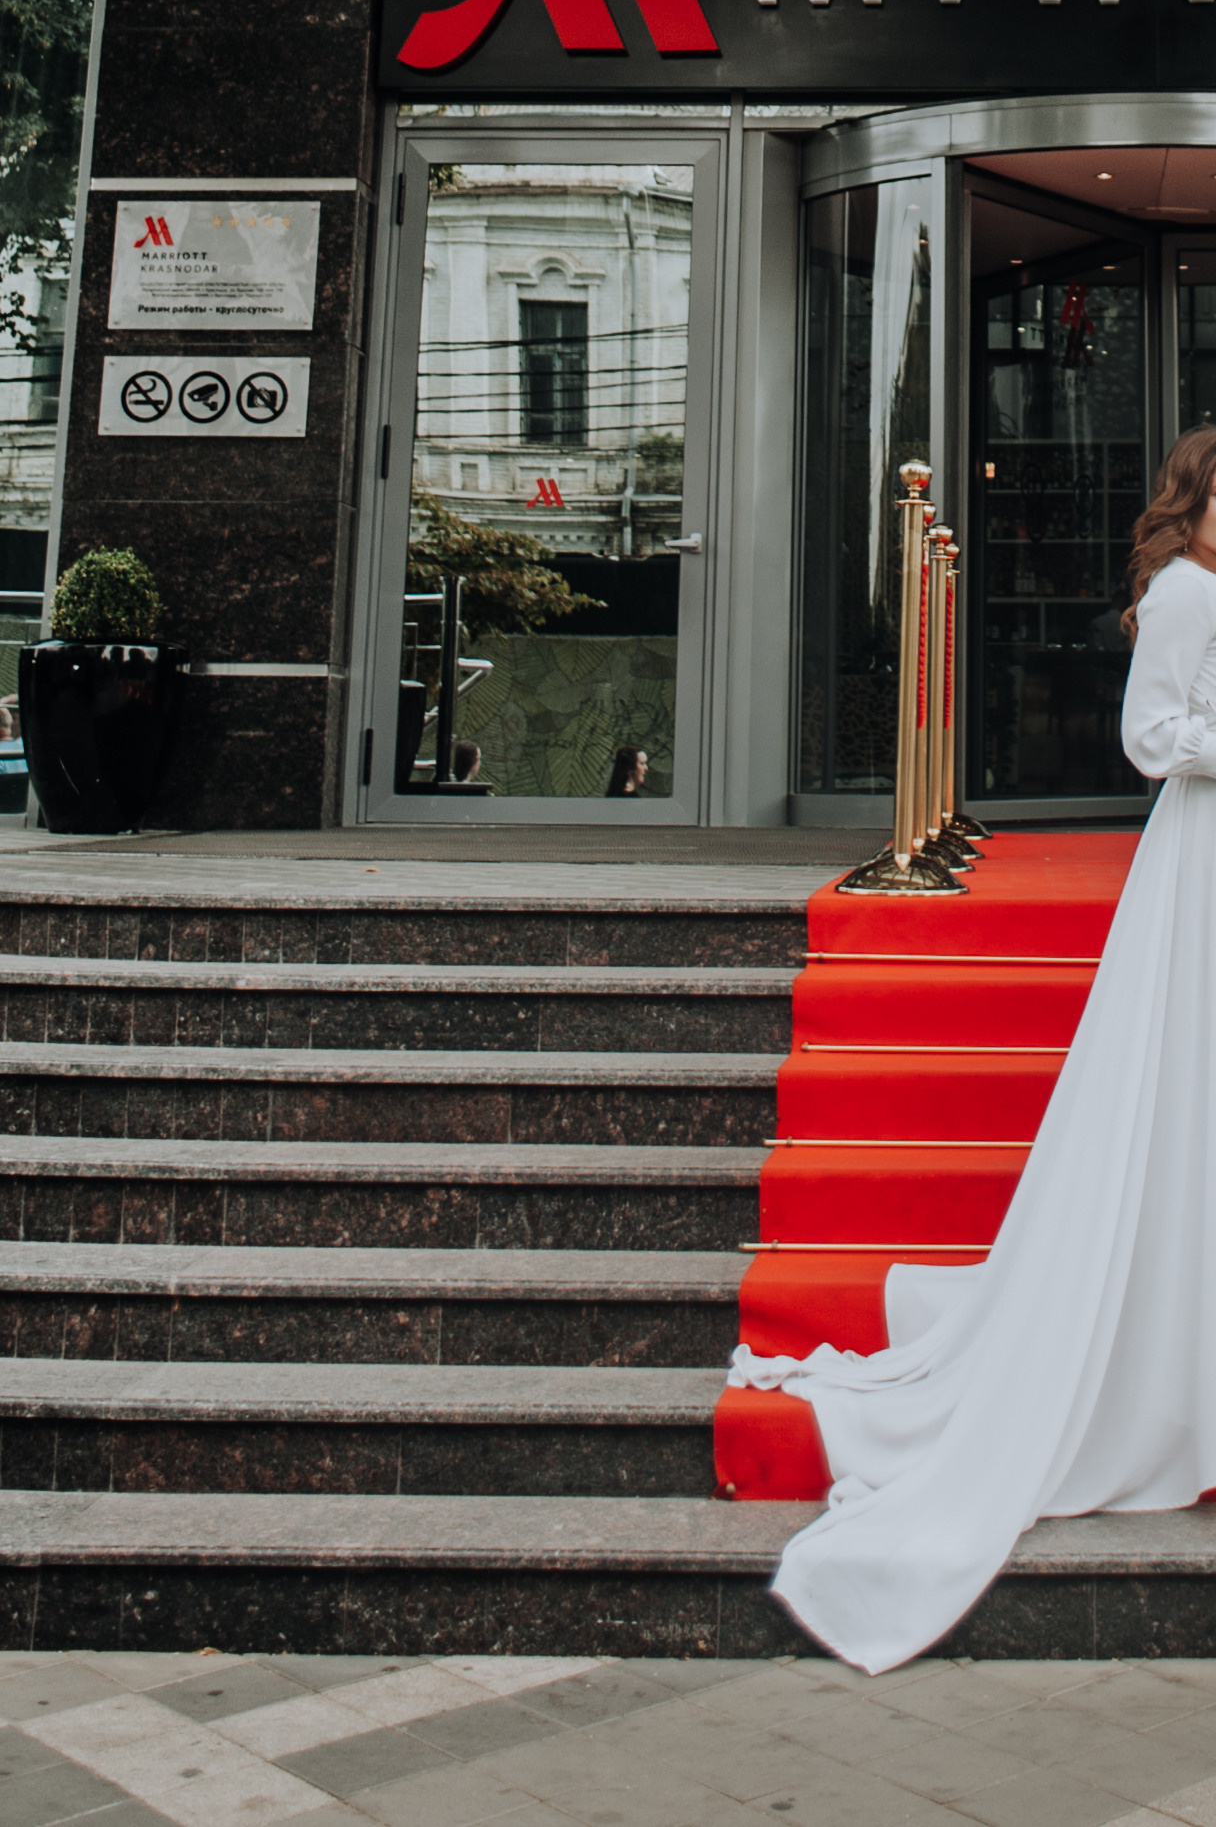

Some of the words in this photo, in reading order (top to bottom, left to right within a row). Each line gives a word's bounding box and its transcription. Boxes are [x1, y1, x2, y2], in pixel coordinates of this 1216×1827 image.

[141, 251, 208, 260] MARRIOTT
[140, 265, 219, 273] KRASNODAR
[138, 305, 170, 313] Режим
[172, 305, 207, 315] работы
[216, 306, 284, 315] круглосуточно
